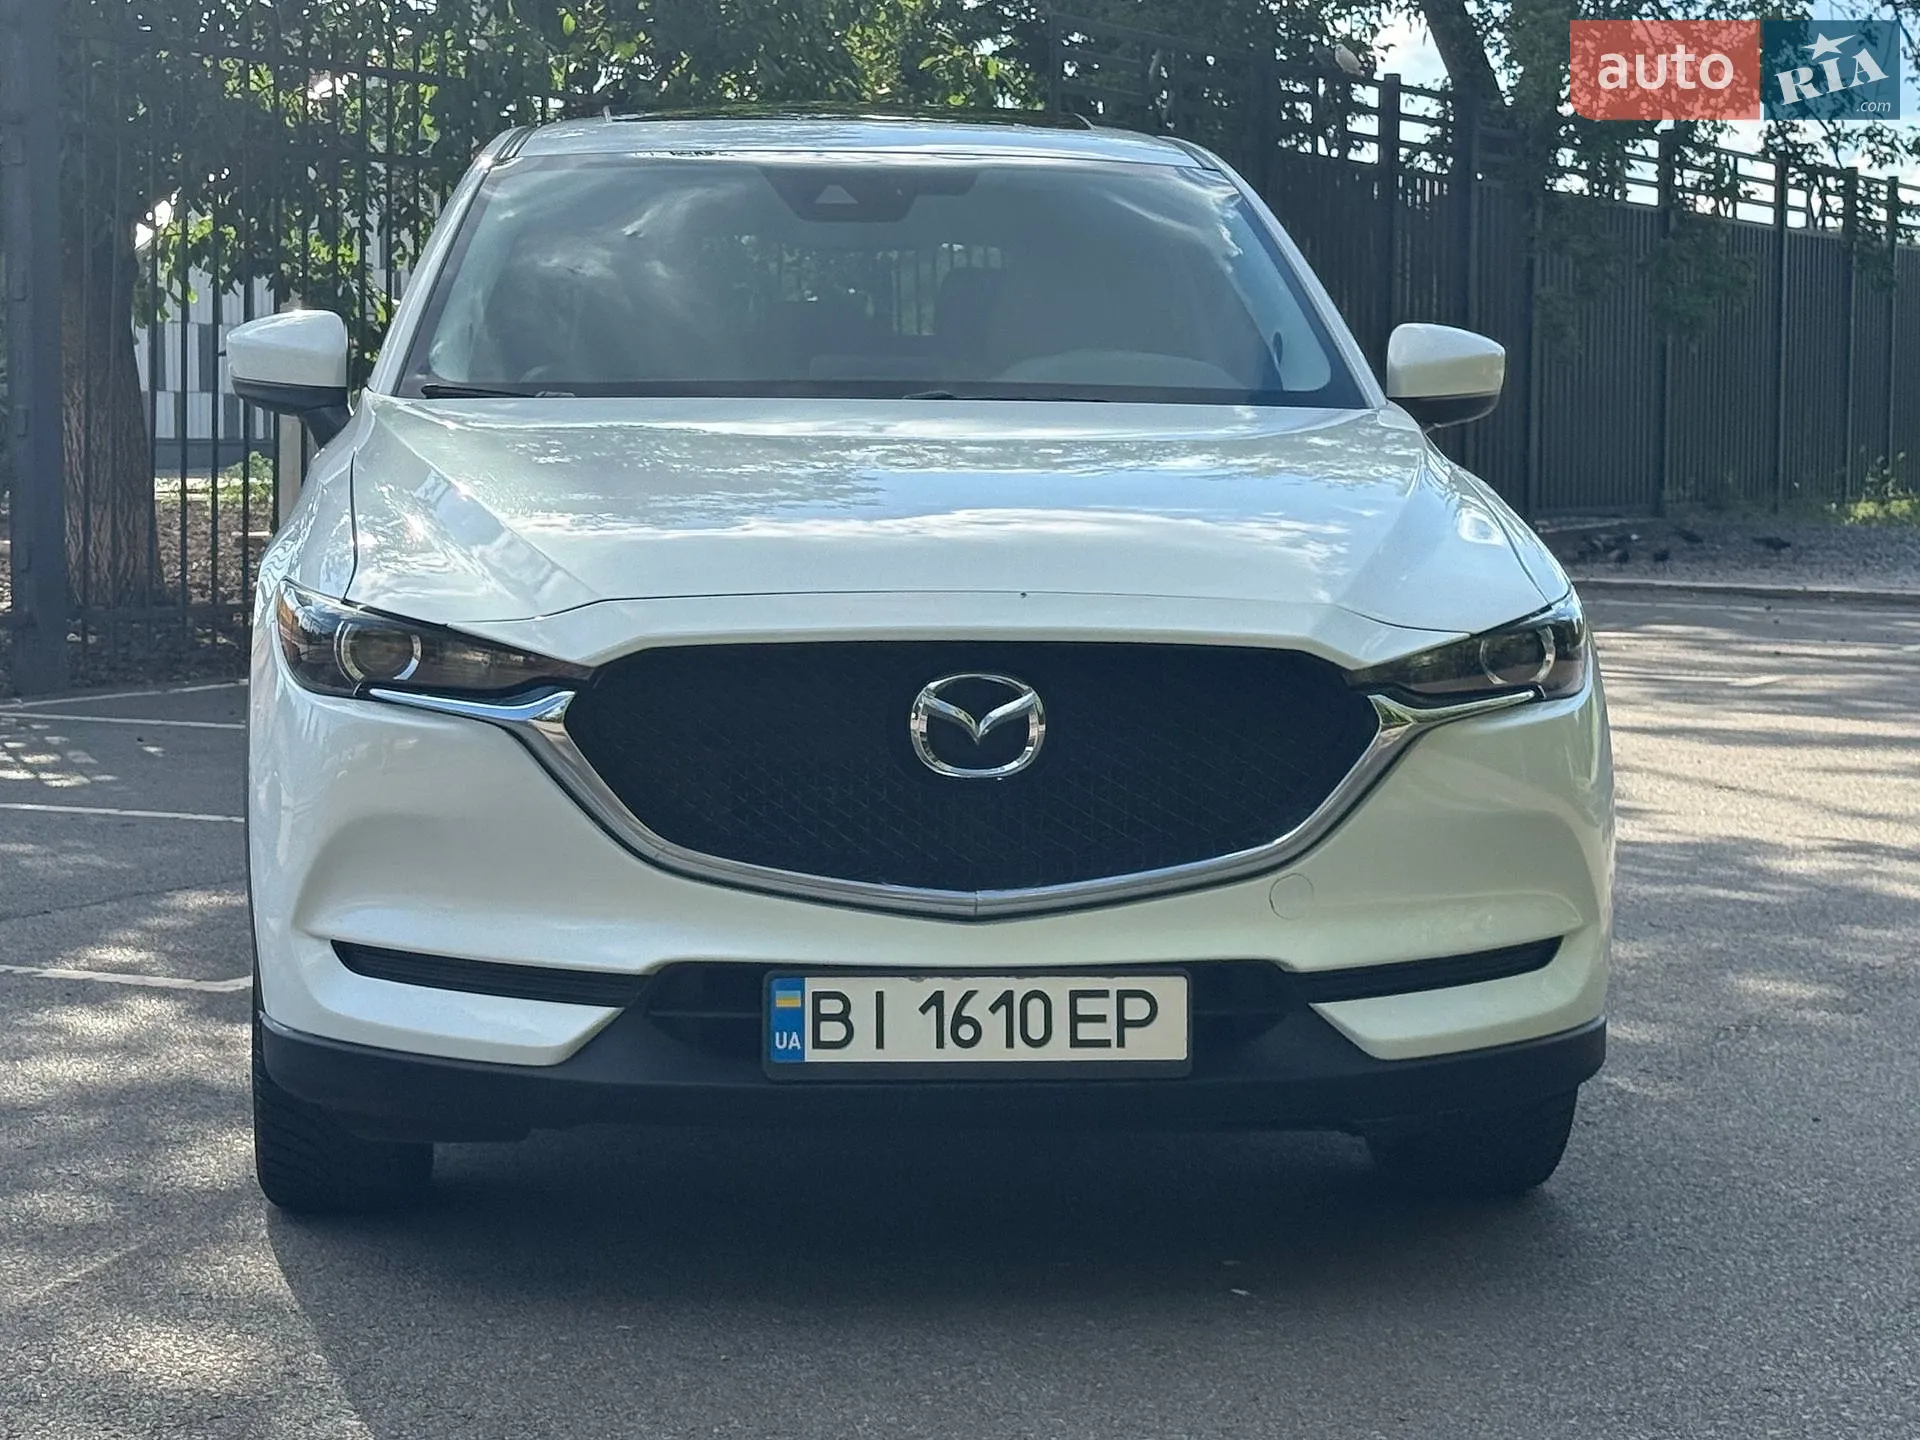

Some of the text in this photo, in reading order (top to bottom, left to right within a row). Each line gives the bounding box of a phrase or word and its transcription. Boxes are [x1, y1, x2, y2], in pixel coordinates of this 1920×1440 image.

[811, 989, 1159, 1050] BI 1610 EP
[774, 1031, 801, 1050] UA
